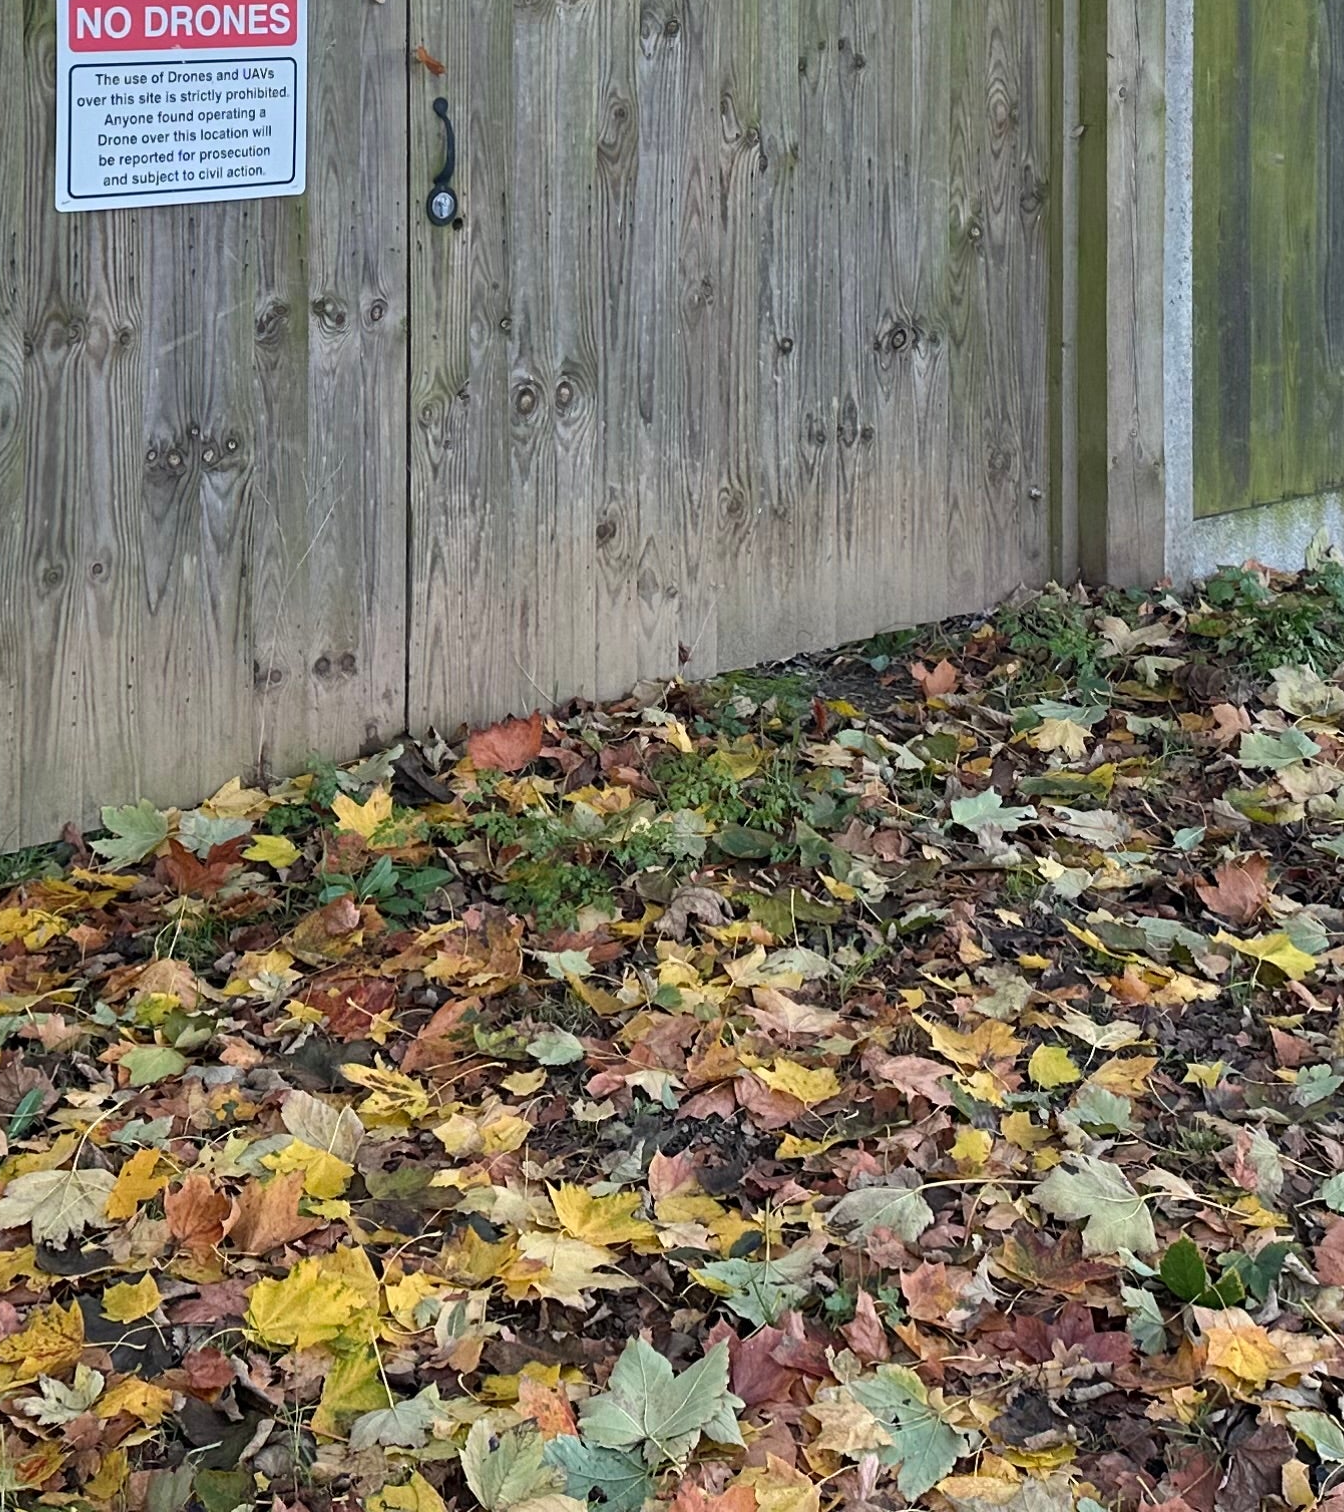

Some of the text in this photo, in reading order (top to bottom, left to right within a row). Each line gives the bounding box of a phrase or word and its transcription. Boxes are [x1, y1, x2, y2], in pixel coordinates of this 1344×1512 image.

[76, 3, 290, 39] NO DRONES
[95, 68, 274, 85] The use of Drones and UAVs
[77, 87, 290, 107] over this site is strictly prohibited.
[104, 108, 266, 128] Anyone found operating a
[98, 126, 272, 146] Drone over this location will
[99, 146, 270, 167] be reported for prosecution
[103, 165, 266, 186] and subject to civil action.
